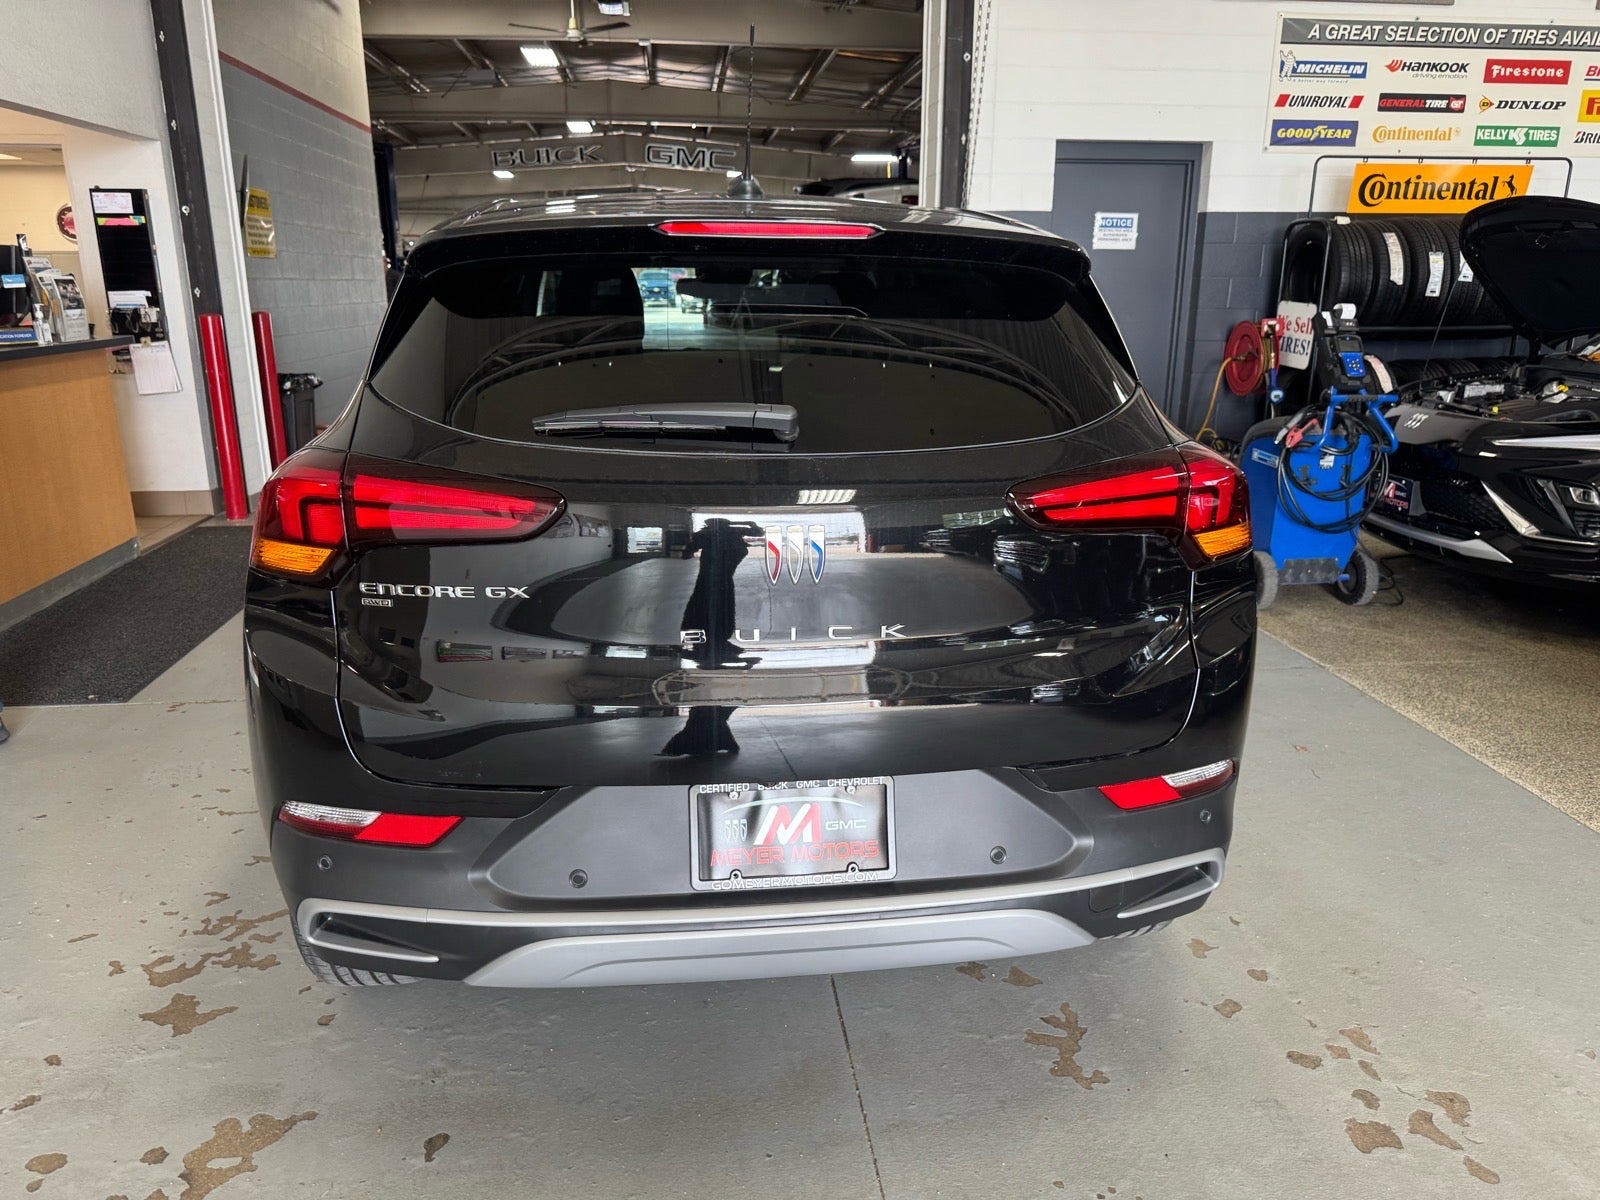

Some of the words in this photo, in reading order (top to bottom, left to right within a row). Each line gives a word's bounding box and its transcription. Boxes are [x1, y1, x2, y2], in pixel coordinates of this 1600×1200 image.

[1308, 24, 1320, 39] A
[1325, 24, 1383, 41] GREAT
[1385, 25, 1480, 43] SELECTION
[1483, 28, 1508, 44] OF
[1511, 28, 1558, 45] TIRES
[1296, 63, 1365, 75] MICHELIN
[1491, 64, 1564, 77] Firestone
[1289, 95, 1347, 108] UNIROYAL
[1495, 100, 1566, 110] DUNLOP
[1277, 125, 1352, 141] GOODYEAR
[1372, 125, 1452, 143] Continental
[1477, 129, 1509, 140] KELLY
[1528, 130, 1557, 141] TIRES
[492, 144, 603, 168] BUICK
[645, 143, 737, 171] GMC
[1358, 173, 1499, 206] Continental
[1099, 218, 1133, 228] NOTICE
[1294, 316, 1313, 335] Sell
[1279, 336, 1311, 356] IRES!
[359, 582, 475, 598] ENCORE
[485, 586, 530, 599] GX
[680, 623, 905, 644] BUICK
[700, 782, 750, 794] CERTIFIED
[796, 779, 820, 789] GMC
[827, 776, 885, 787] CHEVROLET
[825, 818, 867, 831] GMC
[710, 846, 784, 867] MEYER
[790, 840, 880, 863] MOTORS
[711, 870, 878, 890] GOMEYERMOTORS.COM
